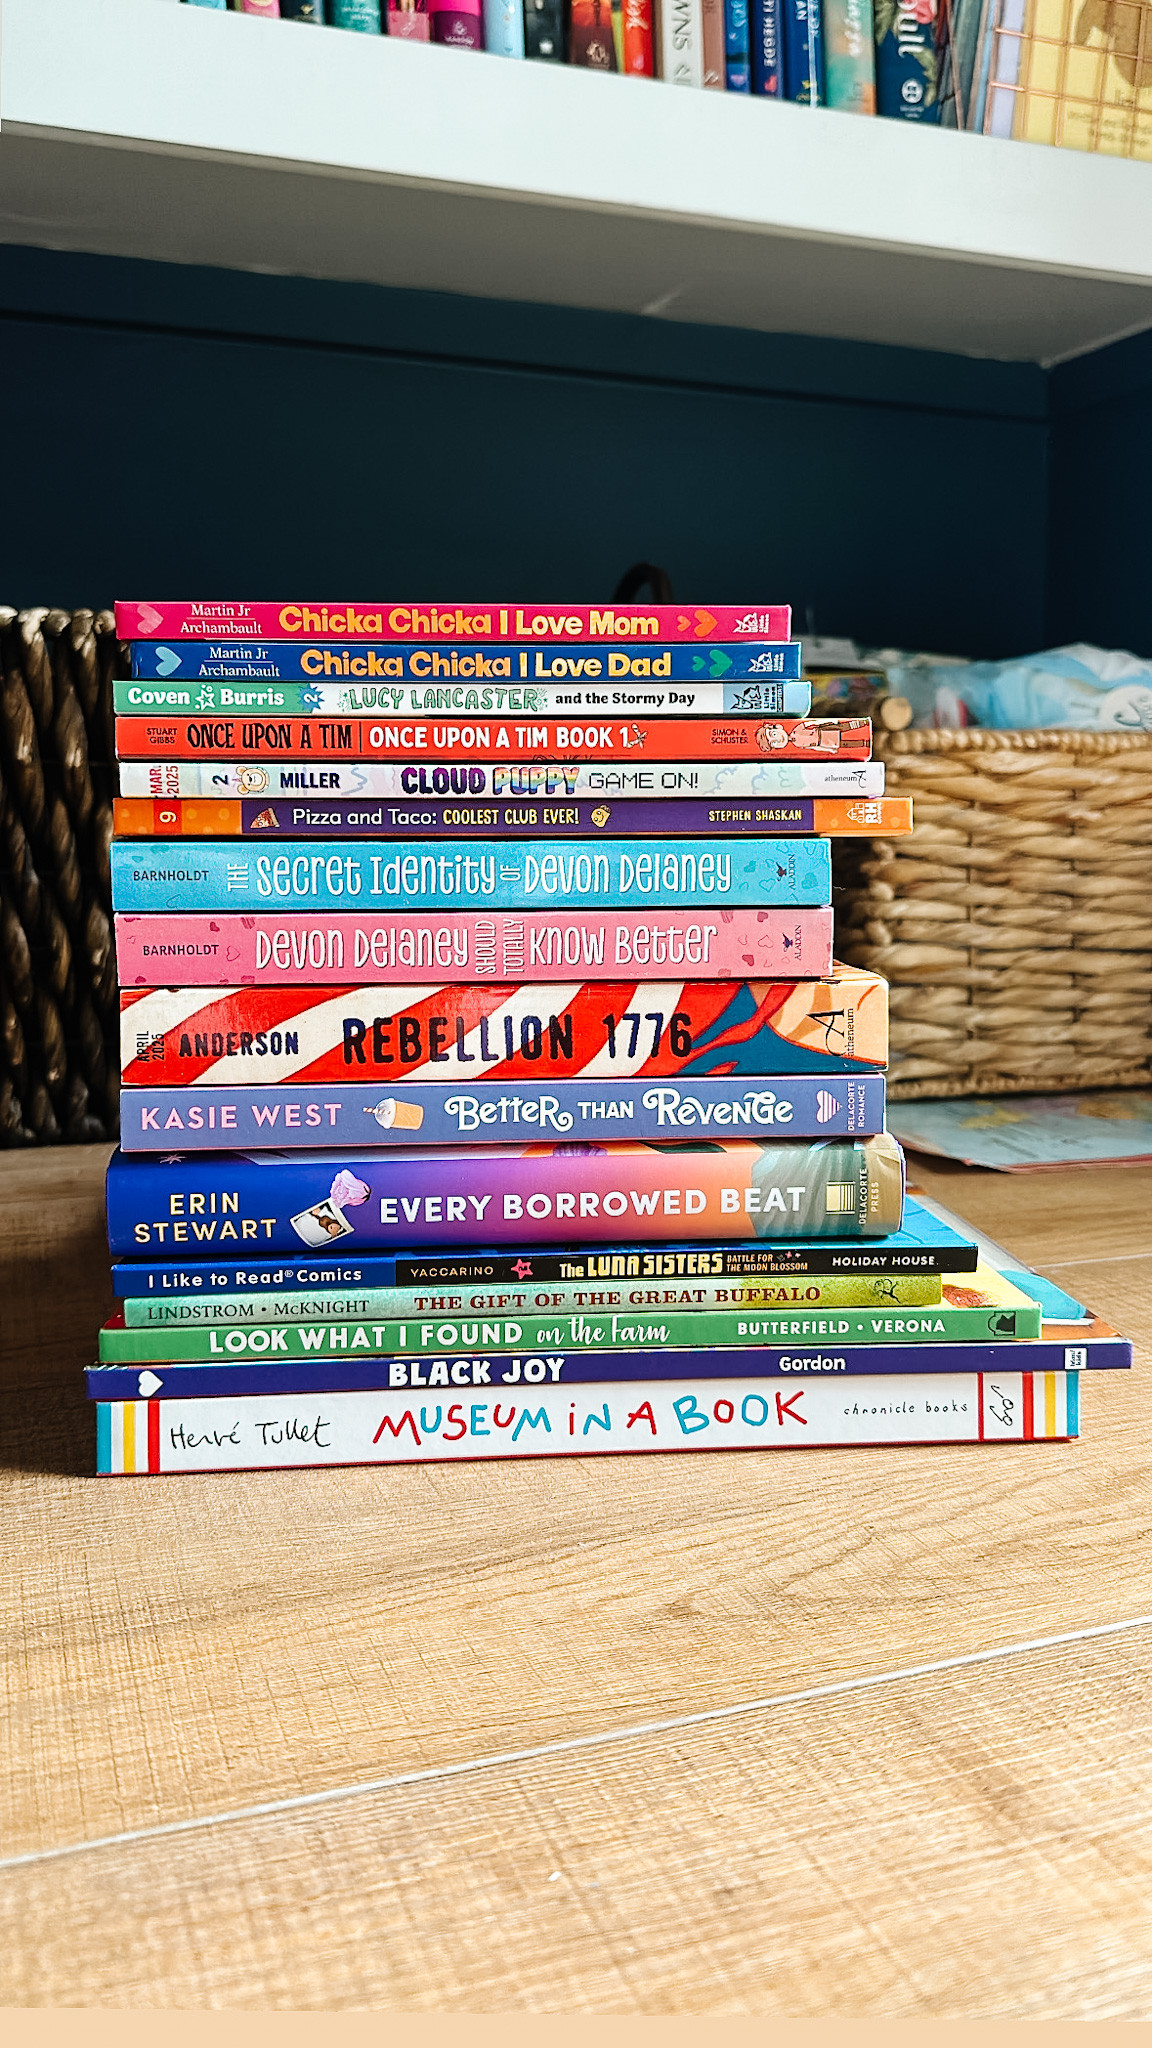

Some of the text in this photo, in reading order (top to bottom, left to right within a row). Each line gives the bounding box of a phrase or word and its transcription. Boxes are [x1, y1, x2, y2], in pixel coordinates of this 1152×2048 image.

[191, 604, 251, 618] Martin Jr
[279, 606, 659, 635] Chicka Chicka I Love Mom
[180, 621, 263, 634] Archambault
[209, 647, 268, 661] Martin Jr
[300, 649, 671, 677] Chicka Chicka I Love Dad
[199, 664, 280, 677] Archambault
[127, 688, 284, 706] Coven Burris
[303, 694, 318, 704] 2
[349, 687, 695, 711] LUCY LANCASTER and the Stormy Day
[146, 728, 177, 736] STUART
[150, 736, 175, 744] GIBBS
[187, 723, 235, 749] ONCE
[242, 724, 292, 749] UPON
[300, 724, 312, 749] A
[319, 724, 352, 749] TIM
[369, 727, 427, 748] ONCE
[433, 727, 490, 748] UPON
[496, 727, 510, 748] A
[515, 727, 548, 748] TIM
[556, 727, 613, 748] BOOK
[166, 765, 179, 795] 2025
[212, 774, 229, 785] 2
[280, 767, 698, 795] MILLER CLOUD PUPPY GAME ON!
[292, 808, 580, 825] Pizza and Taco: COOLEST CLUB EVER!
[708, 809, 802, 822] STEPHEN SHASKAN
[865, 803, 878, 823] RH
[133, 870, 209, 881] BARNHOLDT
[227, 862, 249, 891] THE
[256, 855, 363, 896] Secret
[370, 854, 496, 896] Identity
[501, 864, 521, 882] OF
[788, 854, 796, 890] ALADDIN
[142, 944, 219, 956] BARNHOLDT
[475, 919, 496, 975] SHOULD
[503, 918, 525, 975] TOTALLY
[794, 925, 802, 961] ALADDIN
[178, 1031, 299, 1058] ANDERSON
[342, 1012, 692, 1065] REBELLION 1776
[845, 1008, 855, 1057] atheneum
[136, 1030, 150, 1062] APRIL
[151, 1033, 164, 1060] 2025
[141, 1103, 342, 1131] KASIE WEST
[577, 1101, 634, 1120] THAN
[847, 1081, 855, 1131] DELACORTE
[169, 1192, 239, 1215] ERIN
[379, 1186, 806, 1224] EVERY BORROWED BEAT
[858, 1168, 868, 1225] DELACORTE
[870, 1182, 879, 1213] PRESS
[133, 1218, 277, 1243] STEWART
[410, 1253, 723, 1279] YACCARINO The LUNA SISTERS
[726, 1262, 808, 1272] THE MOON BLOSSOM
[727, 1253, 774, 1263] BATTLE FOR
[832, 1255, 935, 1267] HOLIDAY HOUSE
[148, 1274, 154, 1289] I
[162, 1272, 203, 1288] Like
[211, 1272, 228, 1287] to
[296, 1267, 362, 1283] Comics
[147, 1300, 370, 1320] LINDSTROM McKNIGHT
[414, 1286, 820, 1311] THE GIFT OF THE GREAT BUFFALO
[209, 1315, 671, 1353] LOOK WHAT I FOUND on the Farm
[737, 1318, 946, 1336] BUTTERFIELD VERONA
[388, 1357, 565, 1387] BLACK JOY
[779, 1354, 846, 1372] Gordon
[372, 1404, 551, 1446] MUSEUM
[626, 1401, 657, 1435] A
[672, 1391, 807, 1435] BOOK
[843, 1399, 968, 1416] chronicle books
[170, 1416, 331, 1450] Hervé Tullet
